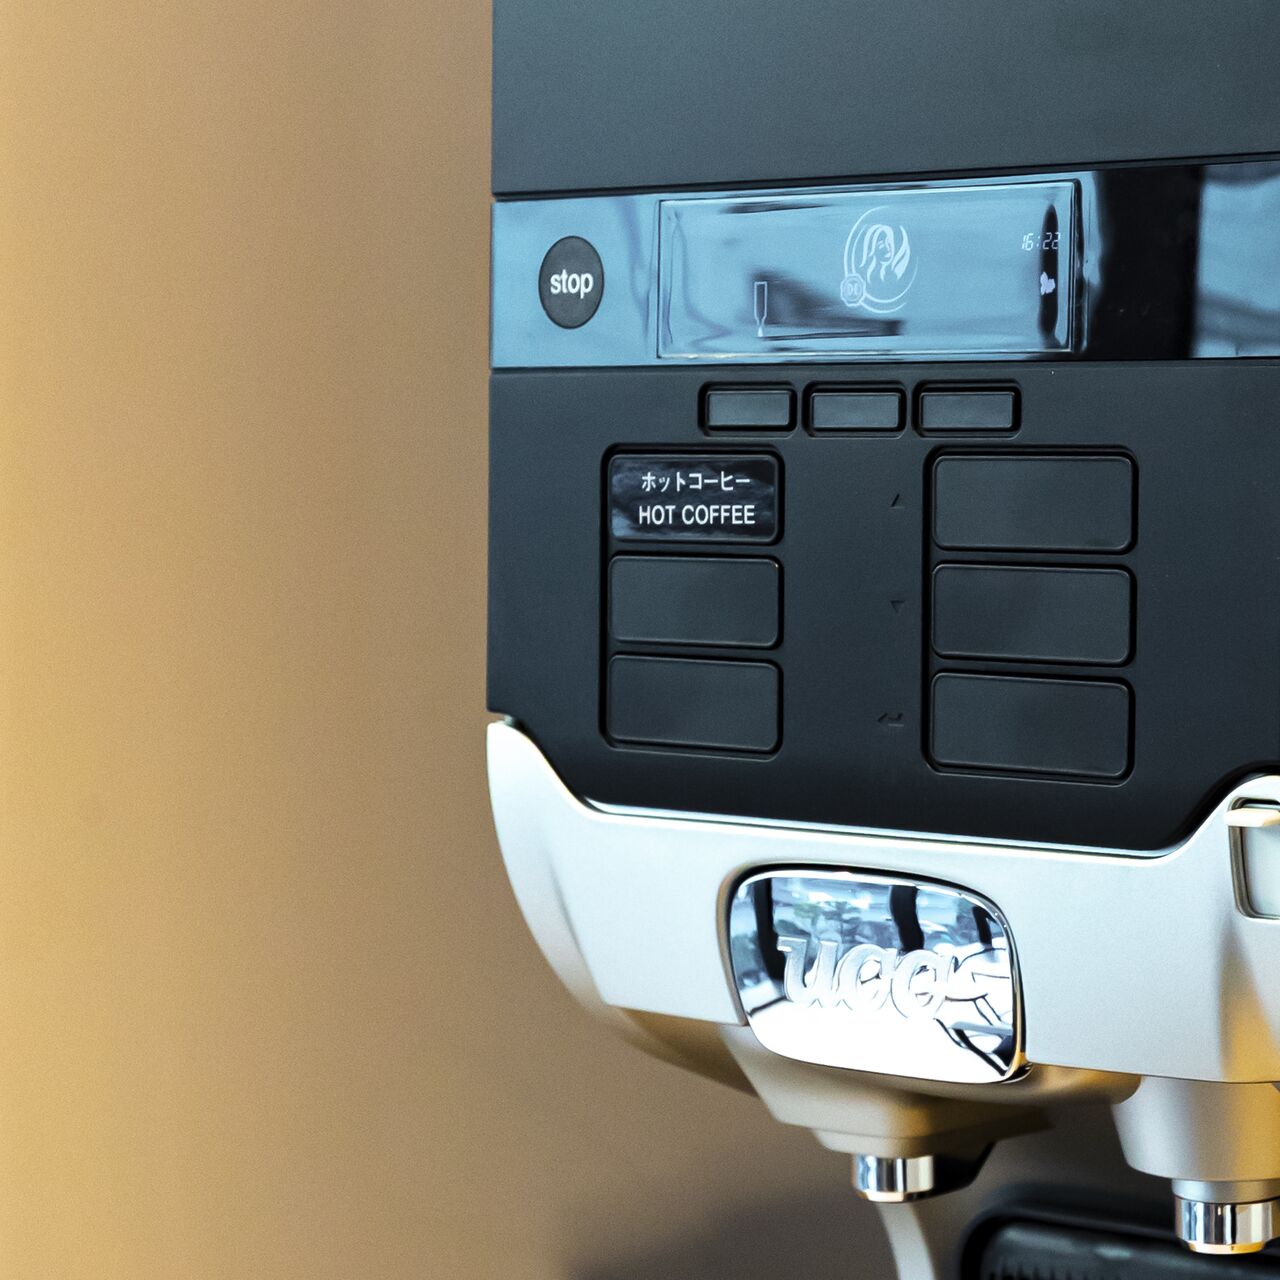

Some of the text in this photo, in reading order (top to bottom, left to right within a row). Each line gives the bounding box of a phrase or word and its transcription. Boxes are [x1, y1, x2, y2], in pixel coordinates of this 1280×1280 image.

[1021, 231, 1061, 251] 16:22
[550, 269, 594, 299] stop
[641, 471, 751, 492] ホットコーヒー
[639, 504, 756, 525] HOT COFFEE
